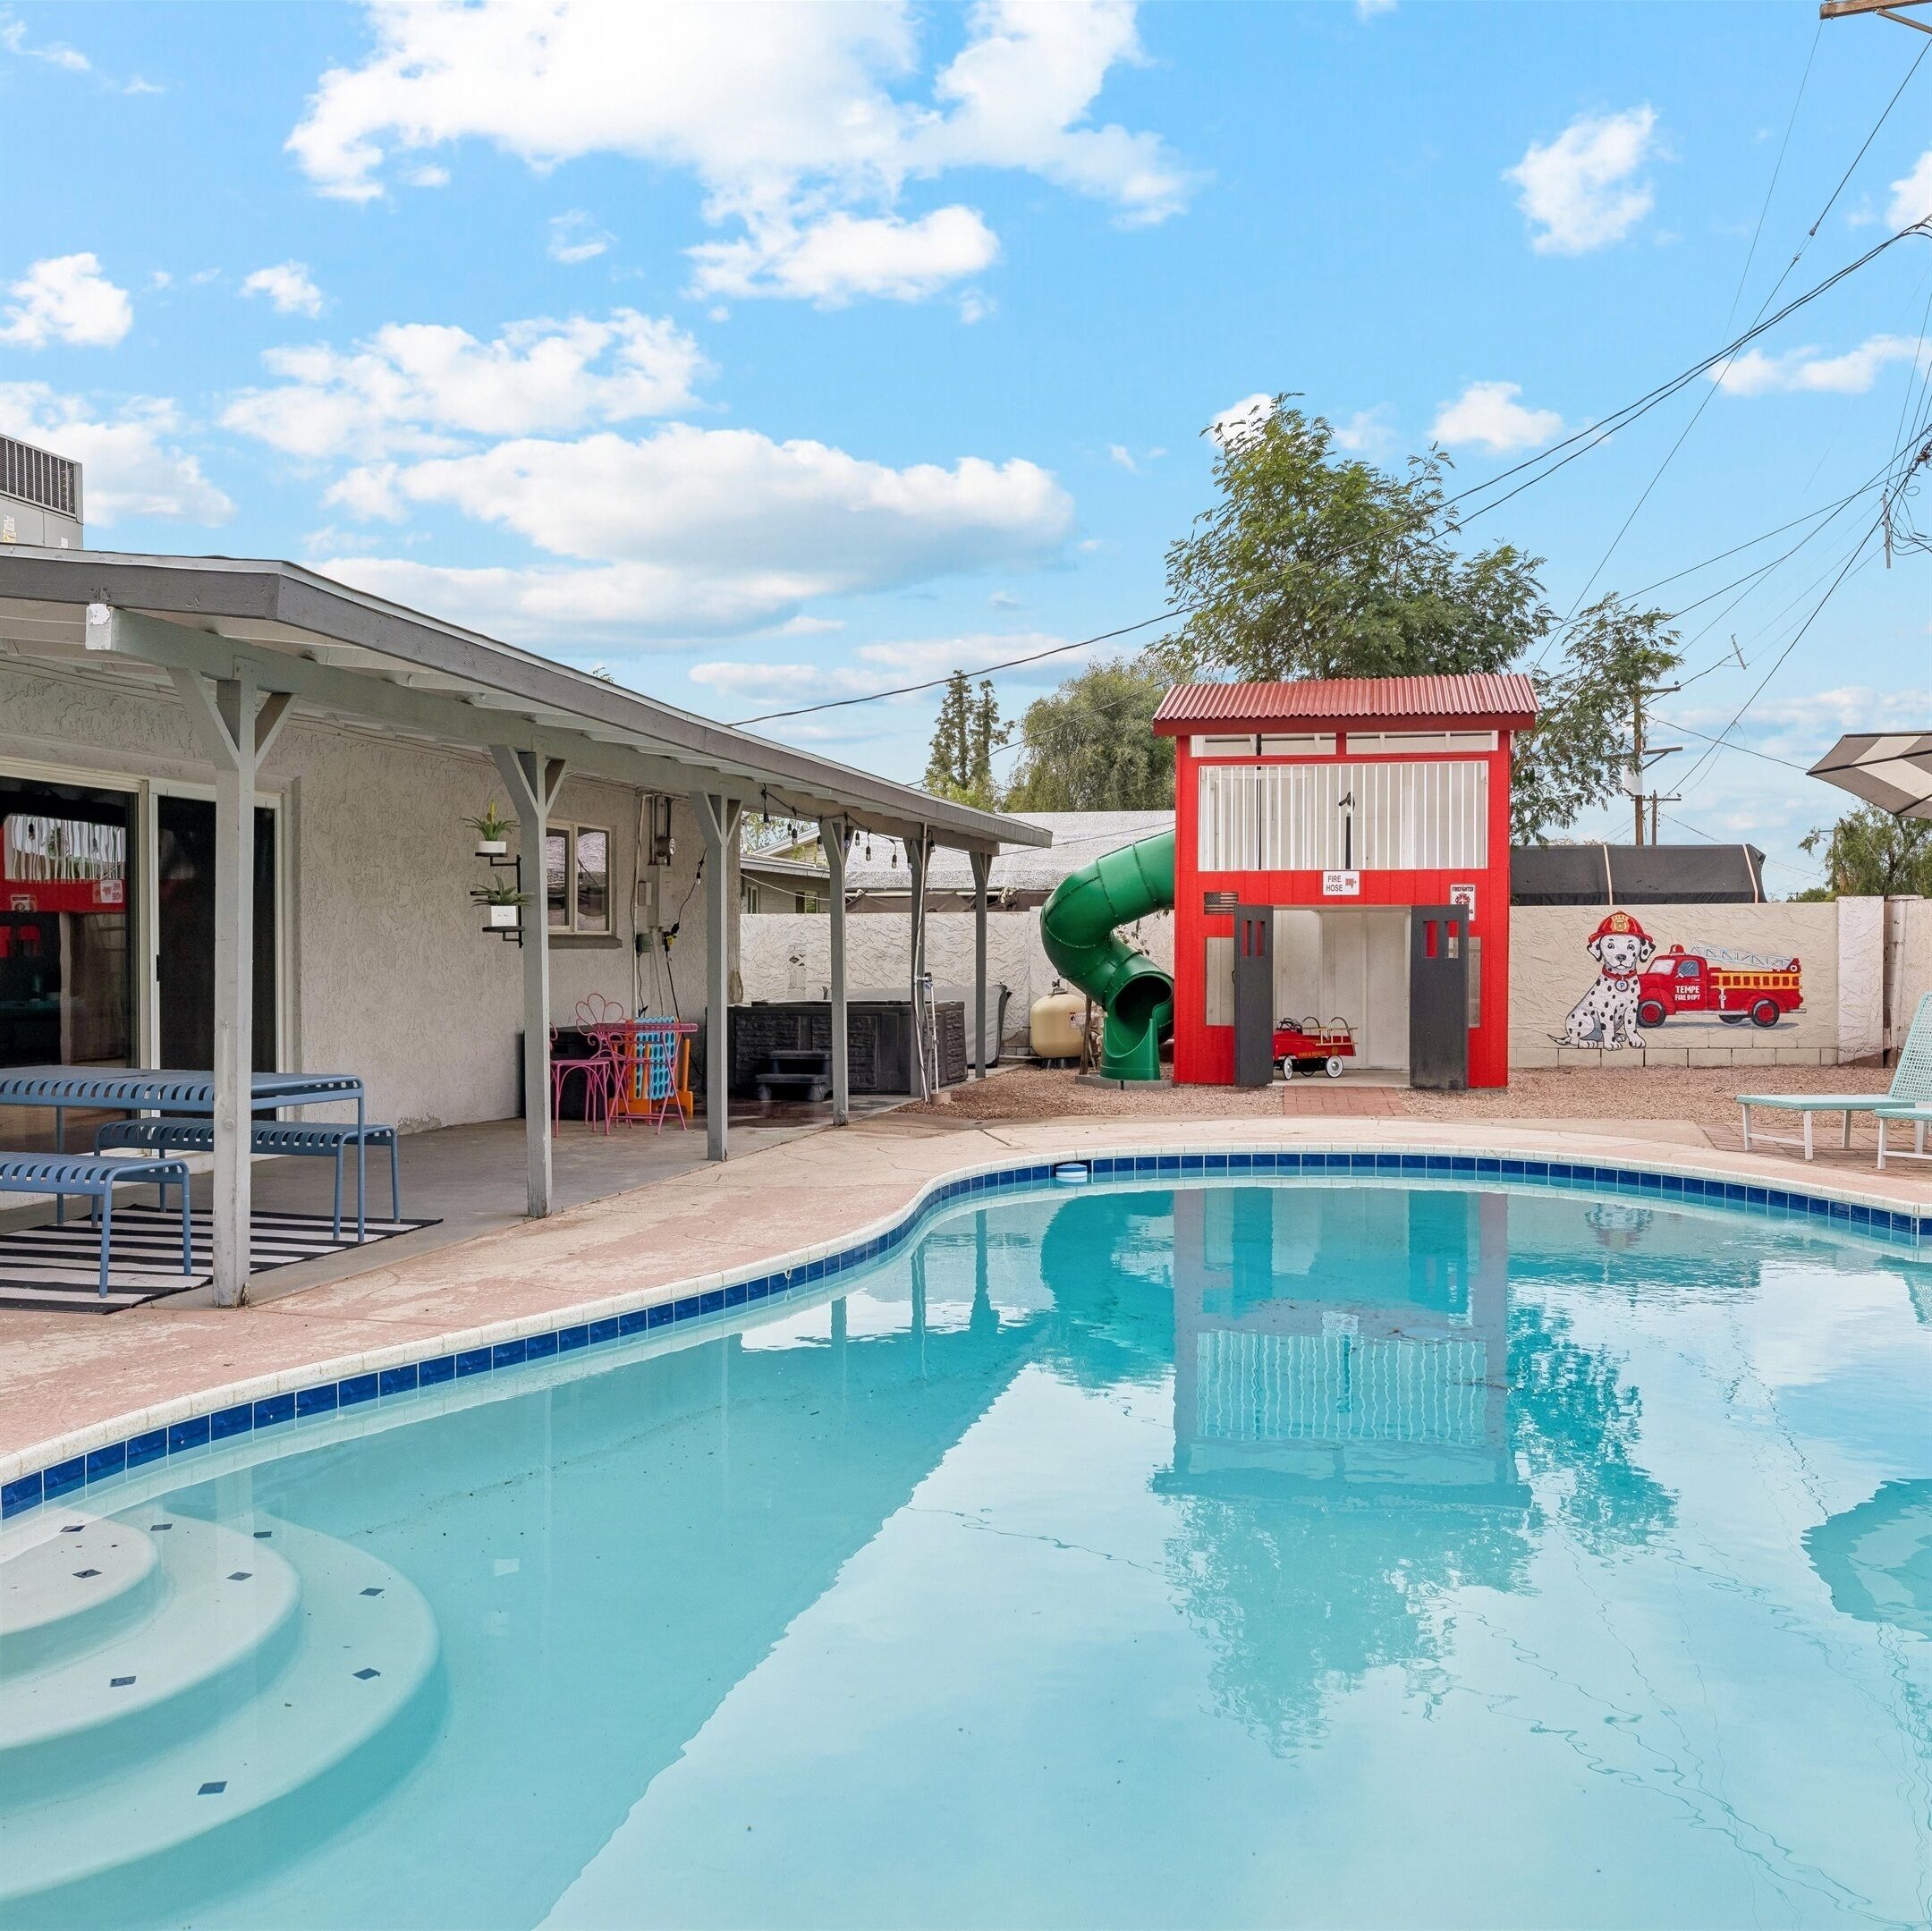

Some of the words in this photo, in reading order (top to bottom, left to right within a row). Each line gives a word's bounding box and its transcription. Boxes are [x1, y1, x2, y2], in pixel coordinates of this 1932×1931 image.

[1327, 875, 1342, 883] FIRE
[1326, 884, 1343, 892] HOSE
[1675, 985, 1700, 994] TEMPE
